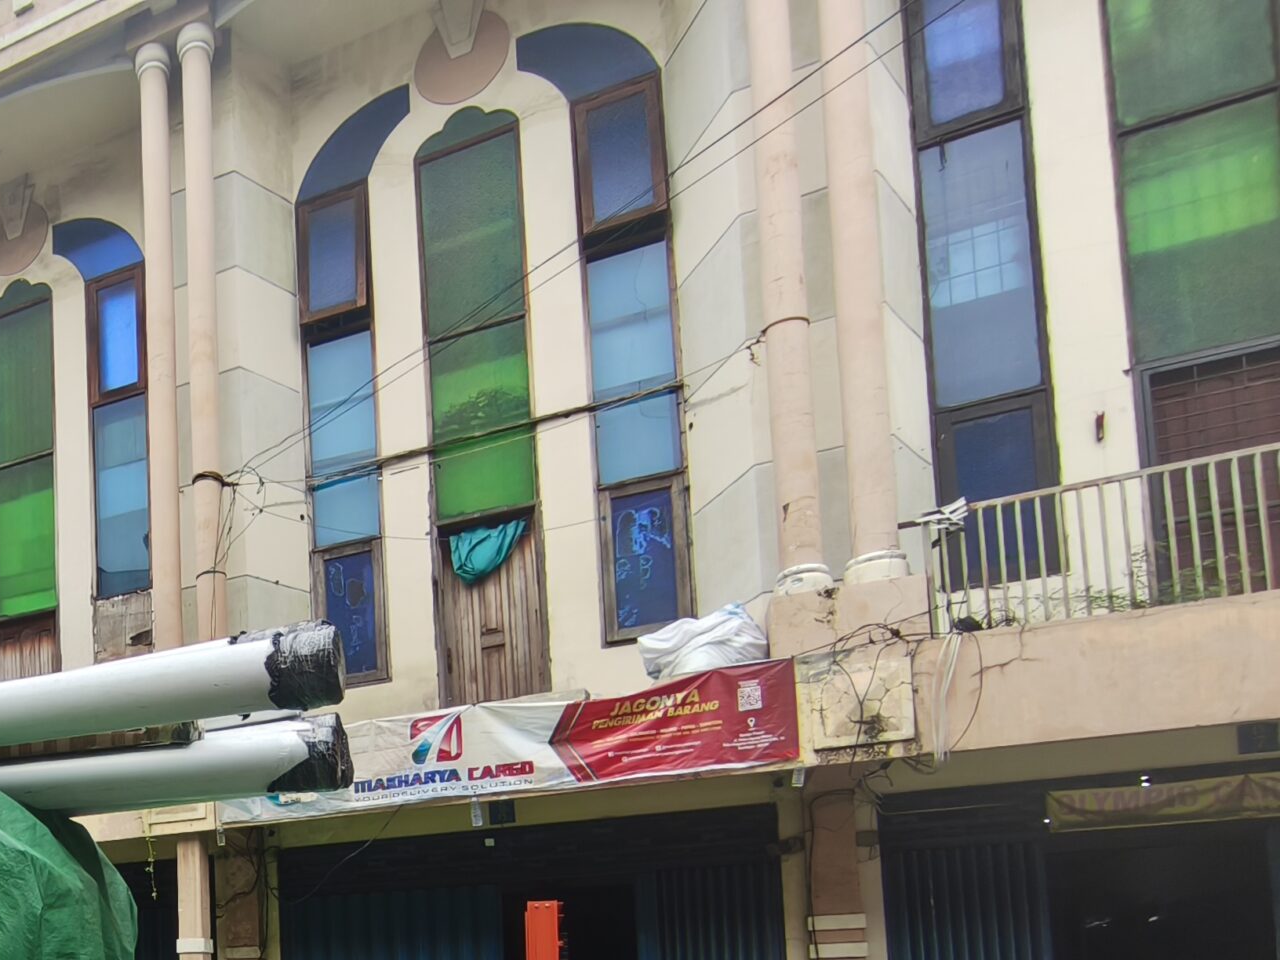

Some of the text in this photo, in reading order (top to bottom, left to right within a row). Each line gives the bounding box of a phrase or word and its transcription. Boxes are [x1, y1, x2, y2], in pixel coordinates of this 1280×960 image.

[592, 700, 720, 730] PENGIRIMAN BARANG
[610, 689, 700, 716] JAGONYA
[354, 761, 535, 794] MAKHARYA CARGO
[354, 779, 534, 802] YOUR DELIVERY SOLUTION
